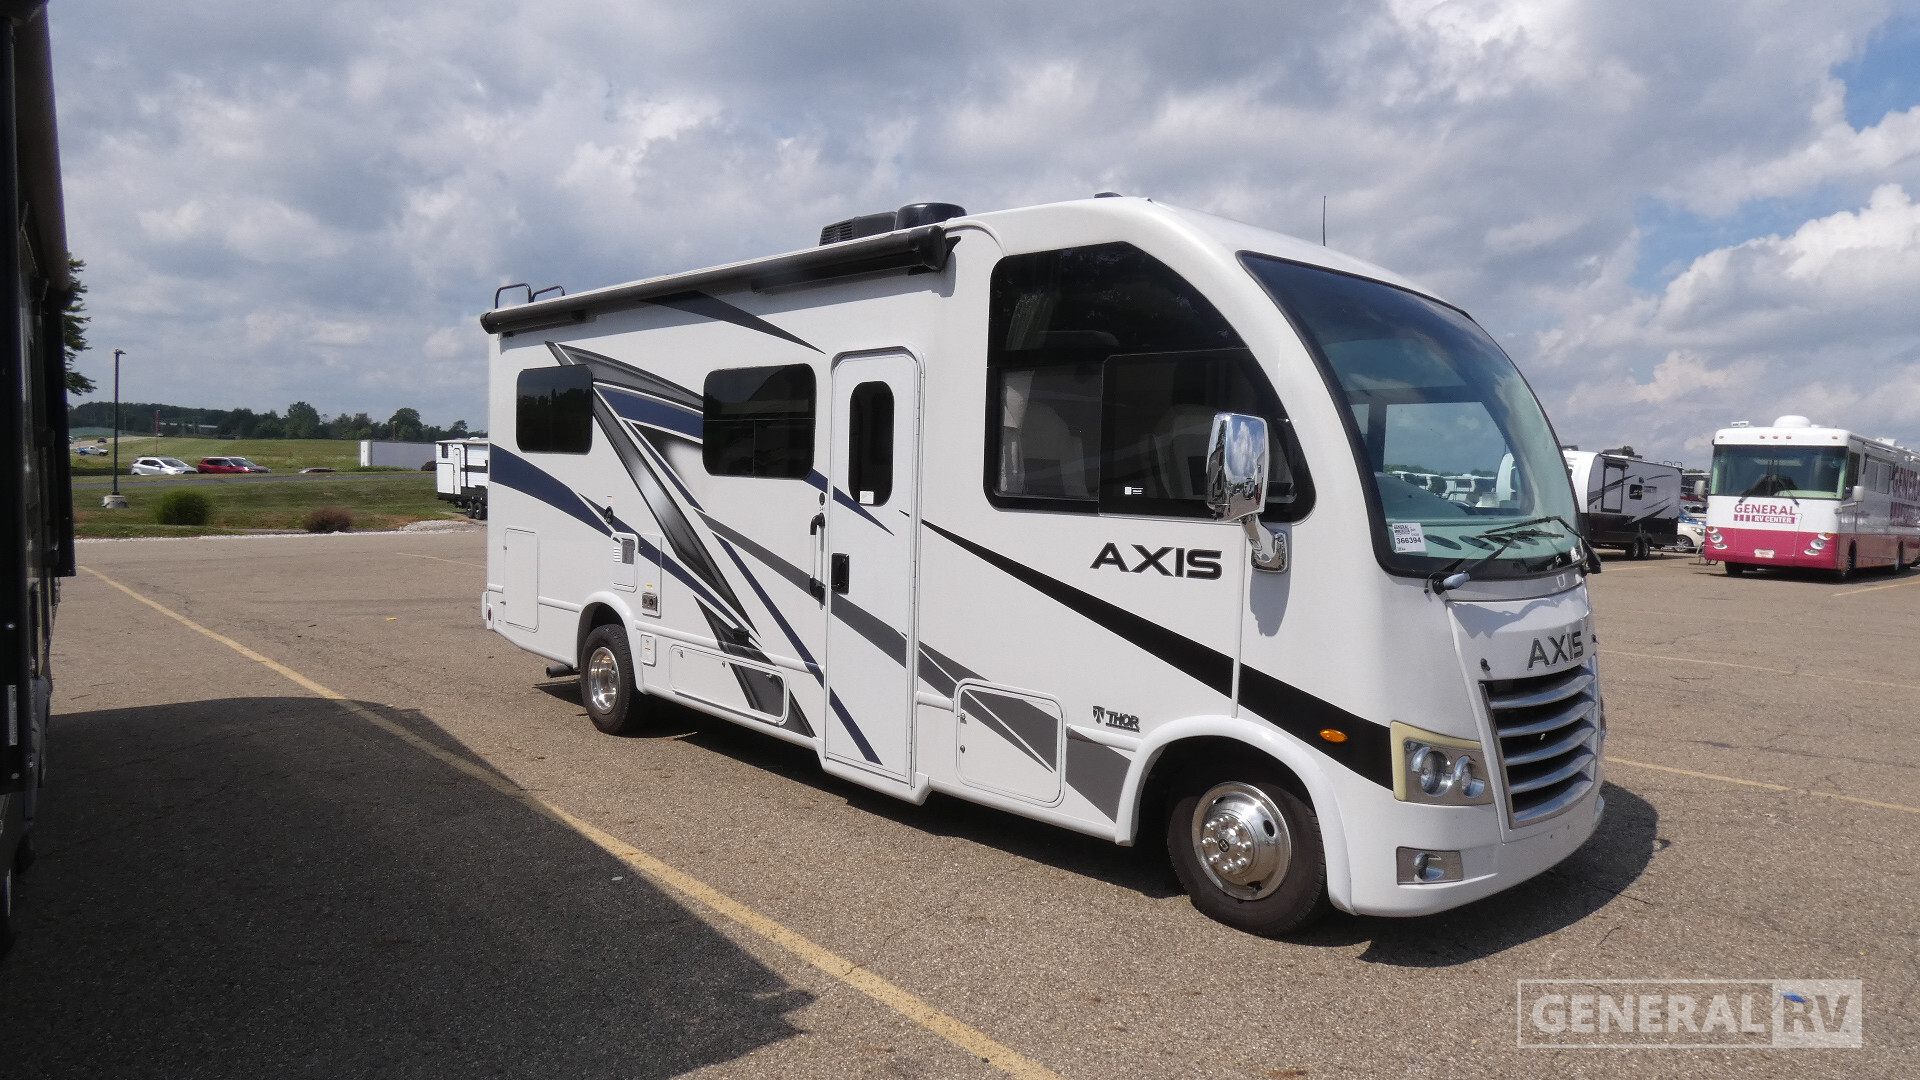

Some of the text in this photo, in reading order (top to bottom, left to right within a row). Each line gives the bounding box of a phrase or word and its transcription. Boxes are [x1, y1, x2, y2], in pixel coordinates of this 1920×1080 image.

[1734, 503, 1796, 515] GENERAL
[1090, 542, 1222, 580] AXIS
[1527, 630, 1584, 671] AXIS
[1106, 710, 1140, 729] THOR
